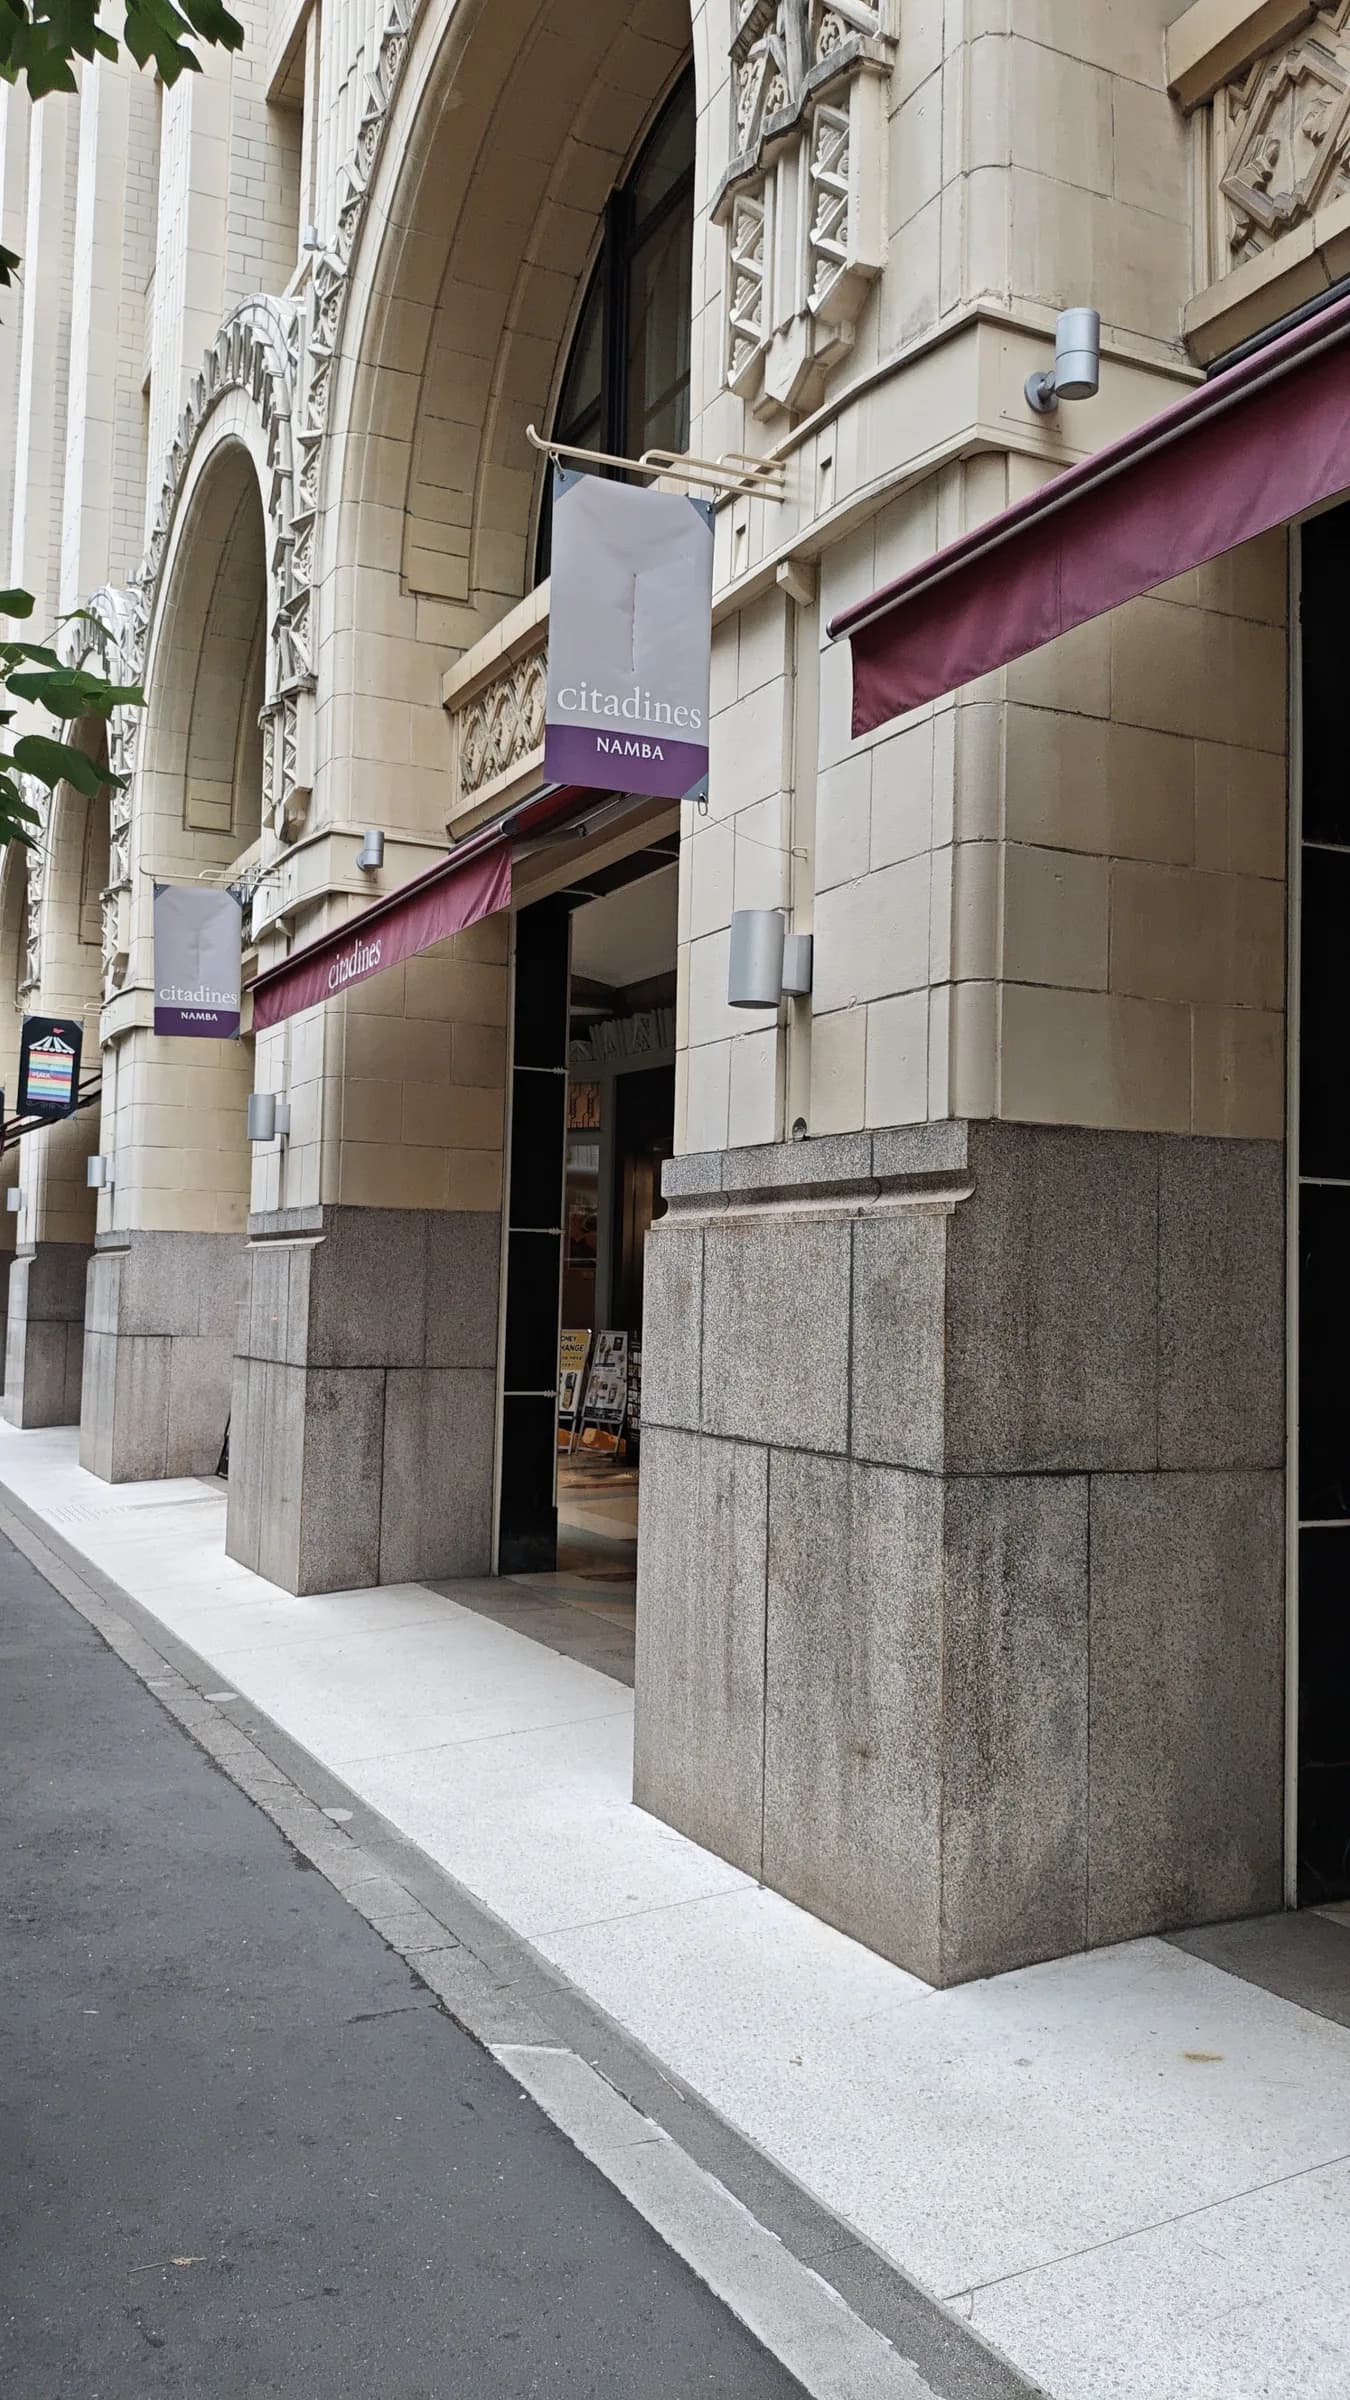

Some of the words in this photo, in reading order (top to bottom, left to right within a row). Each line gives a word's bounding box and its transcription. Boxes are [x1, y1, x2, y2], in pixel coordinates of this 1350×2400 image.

[557, 681, 702, 729] citadines
[596, 736, 665, 761] NAMBA
[328, 938, 382, 989] citadines
[159, 985, 237, 1005] citadines
[180, 1011, 218, 1022] NAMBA
